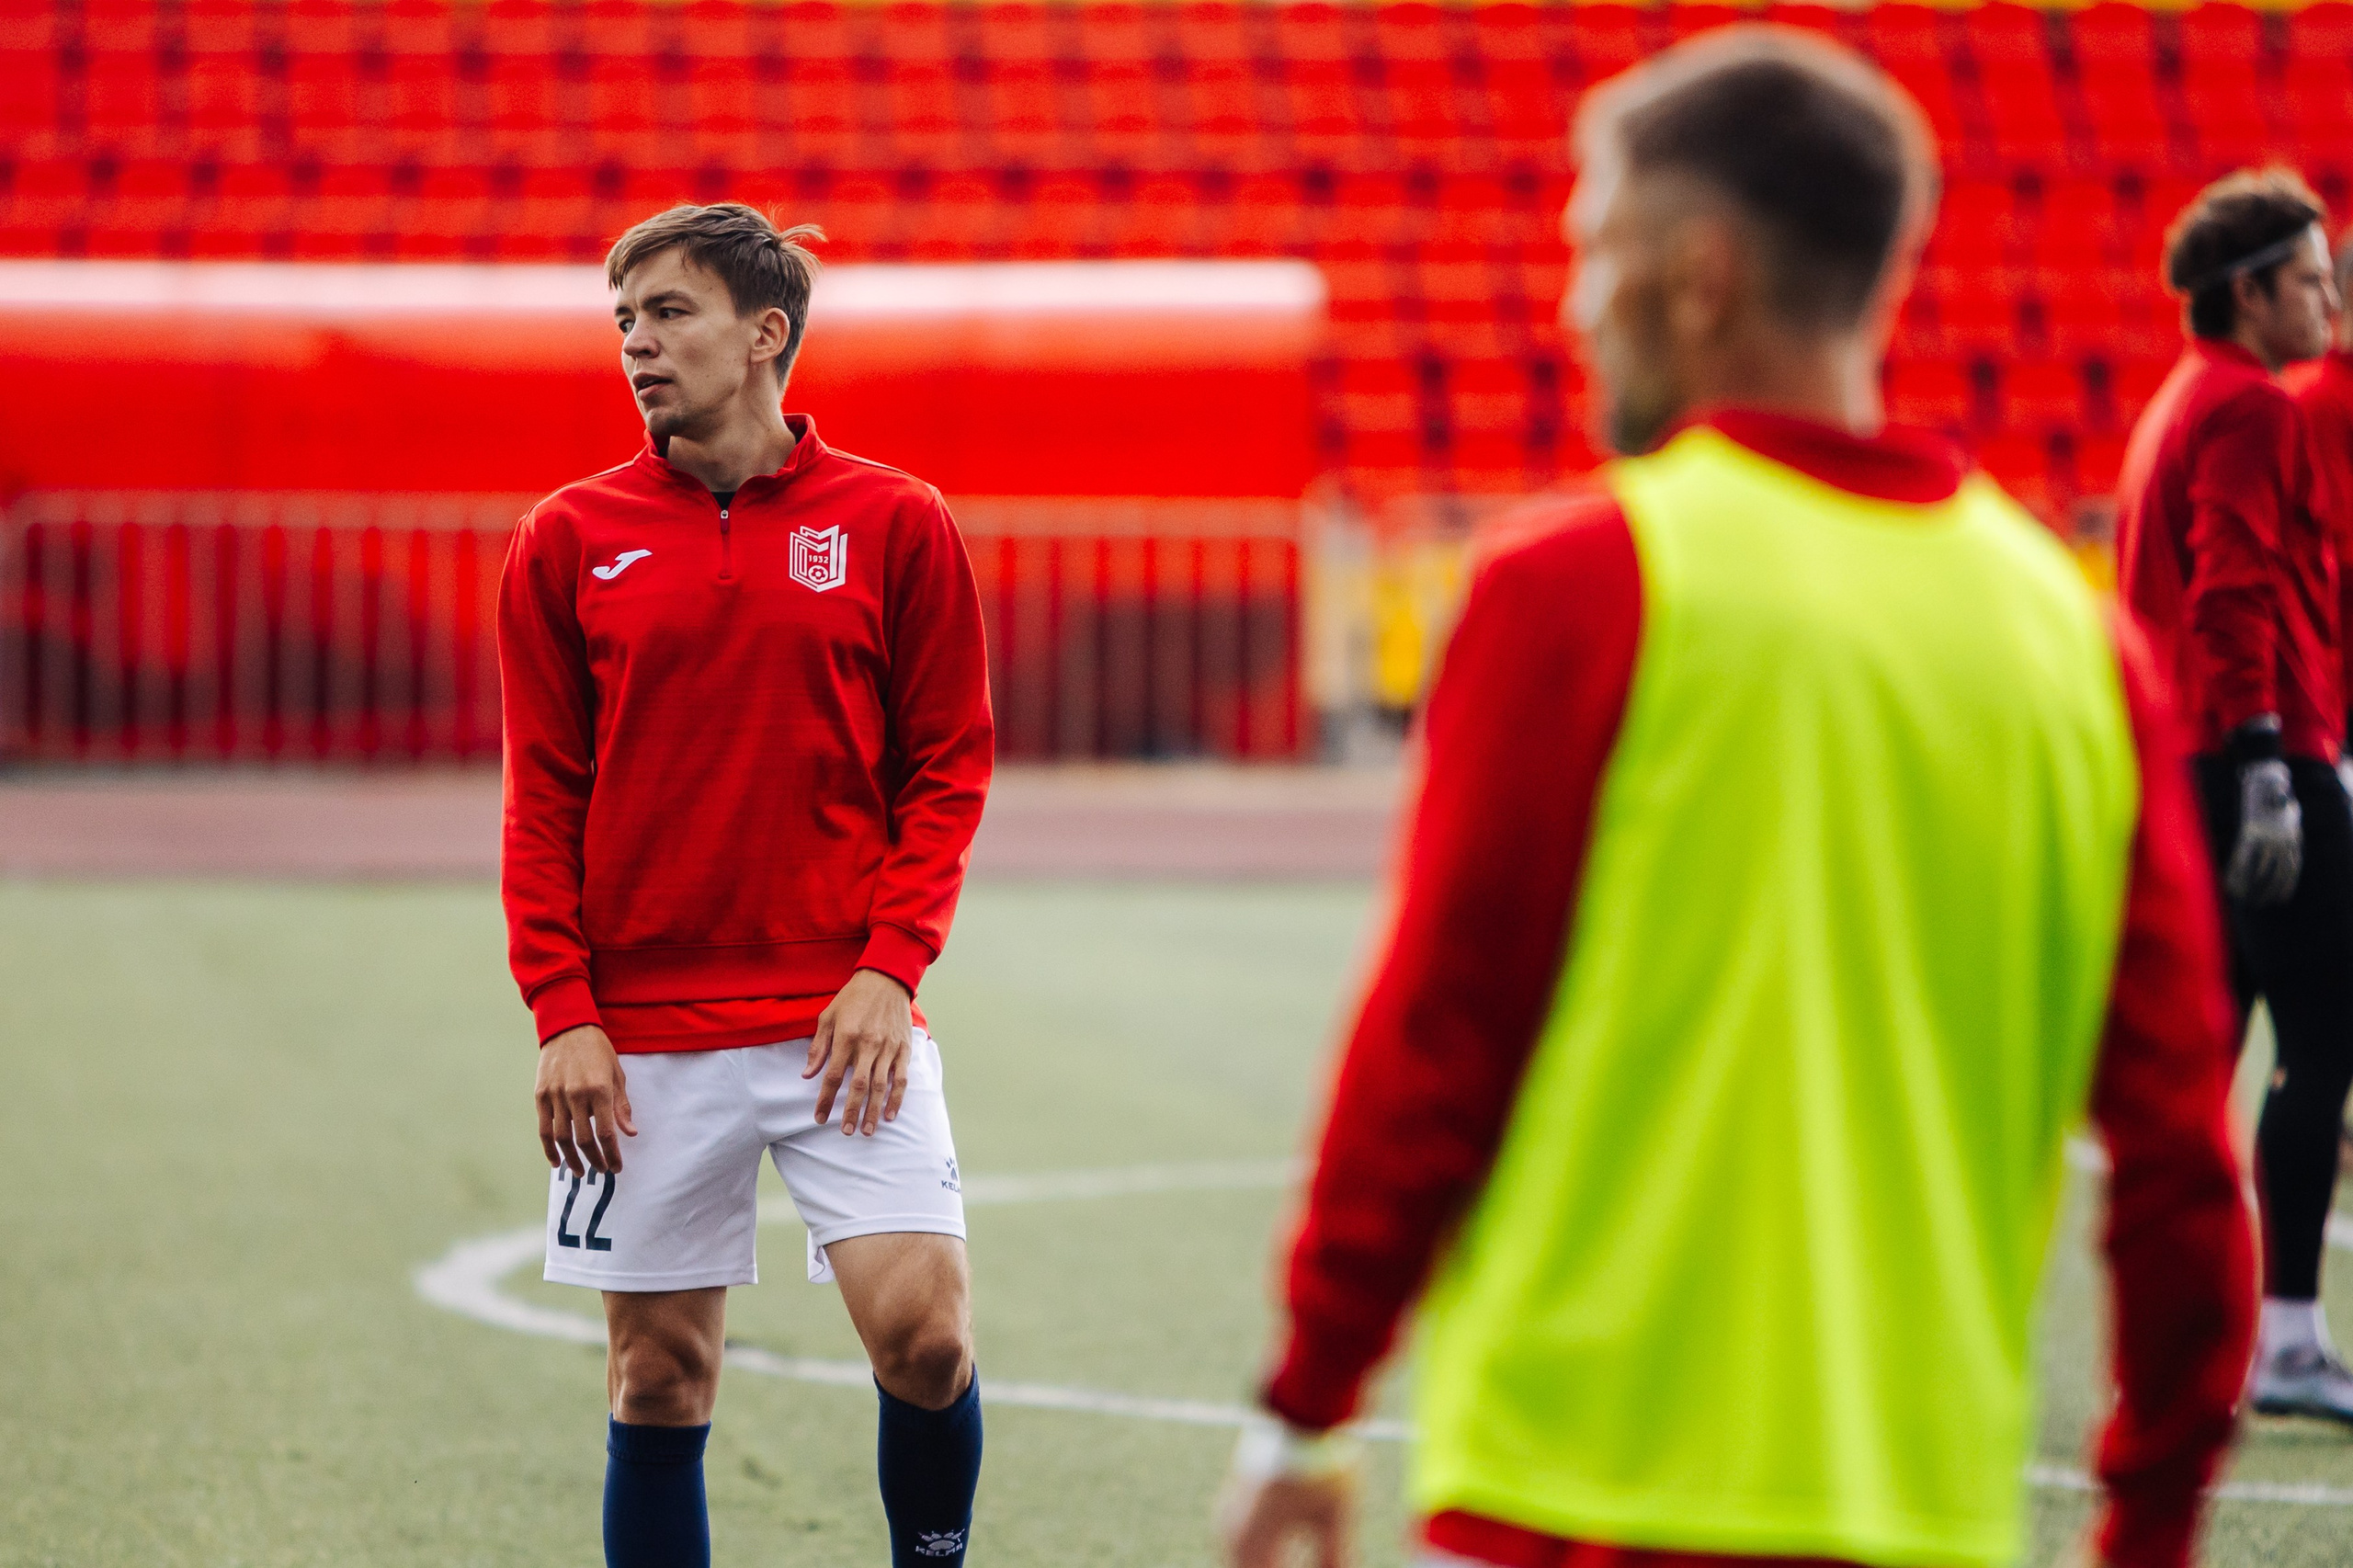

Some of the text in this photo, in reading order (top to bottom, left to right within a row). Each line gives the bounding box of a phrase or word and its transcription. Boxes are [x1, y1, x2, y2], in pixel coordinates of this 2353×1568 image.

[809, 554, 829, 563] 1932
[940, 1179, 961, 1194] KEL
[557, 1158, 616, 1252] 22
